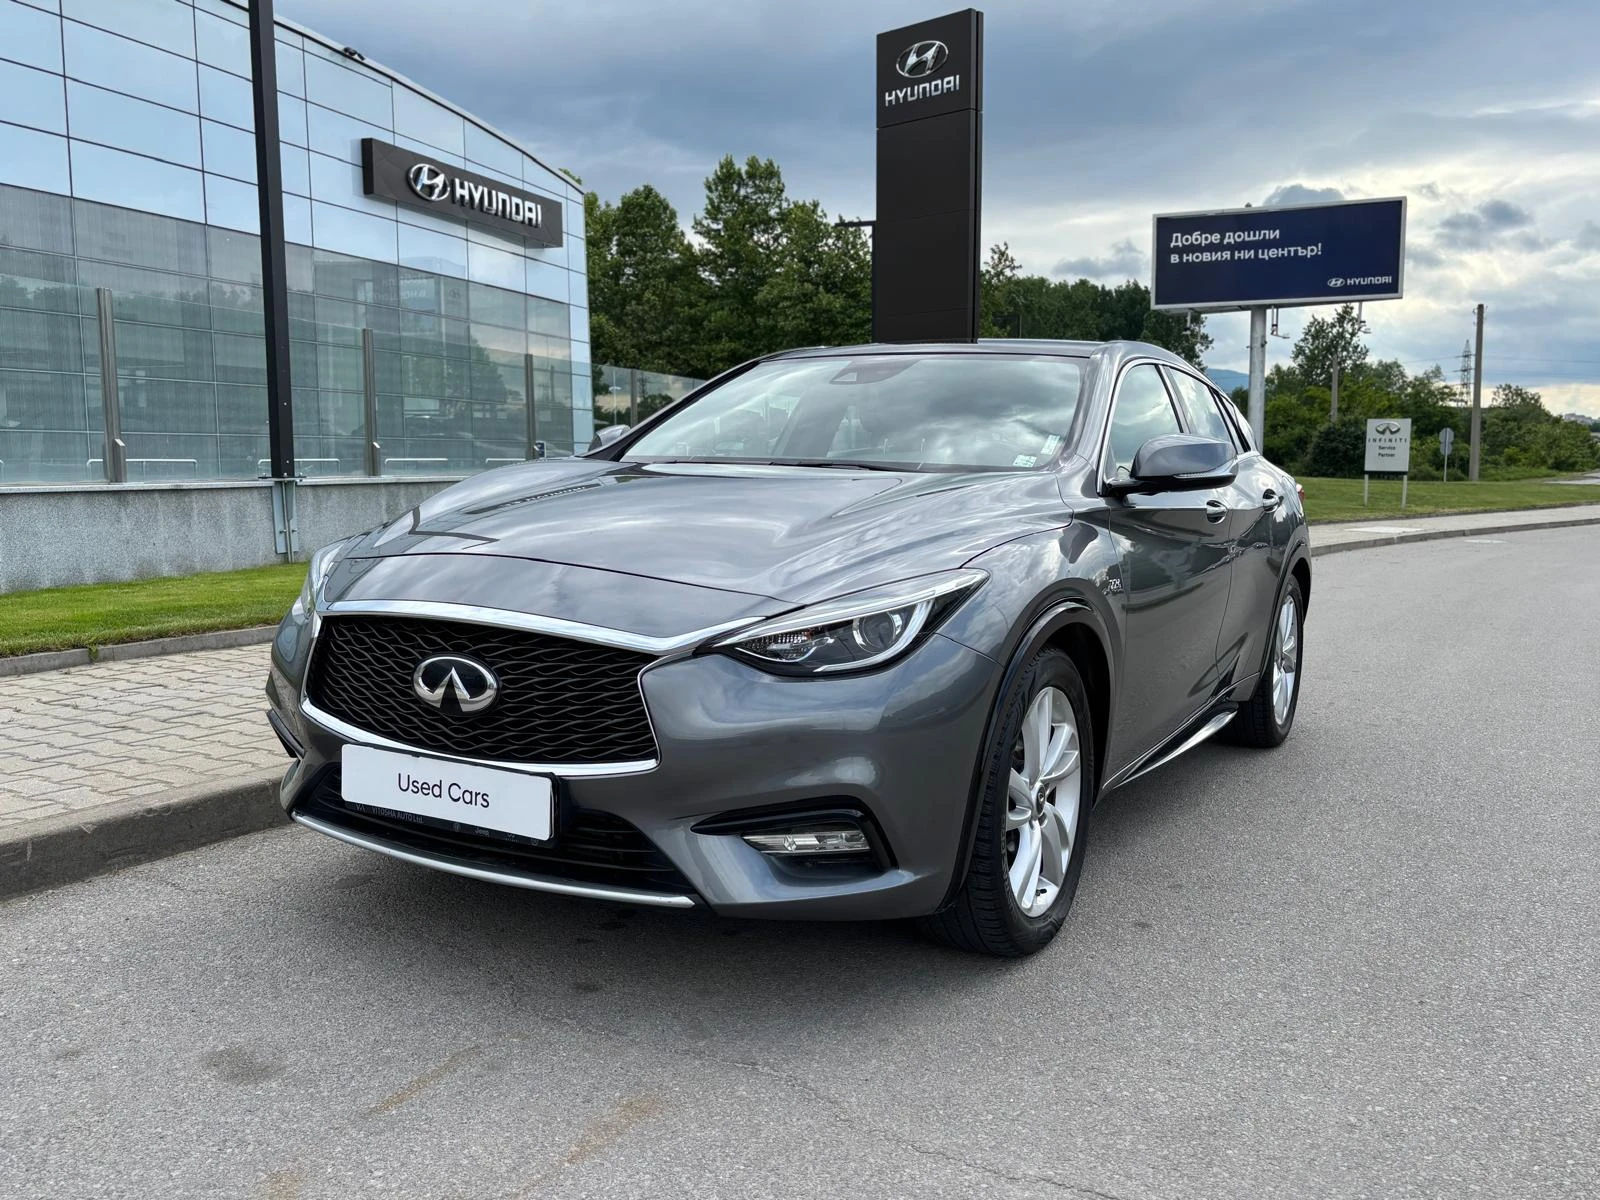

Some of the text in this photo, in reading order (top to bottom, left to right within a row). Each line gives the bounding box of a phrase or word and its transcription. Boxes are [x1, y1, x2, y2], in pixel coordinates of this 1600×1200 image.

[885, 75, 960, 107] HYUNDAI
[453, 178, 542, 228] HYUNDAI
[1170, 229, 1280, 248] Добре дошли
[1170, 242, 1322, 264] в новия ни център!
[1346, 276, 1392, 286] HYUNDAI
[397, 772, 490, 809] Used Cars
